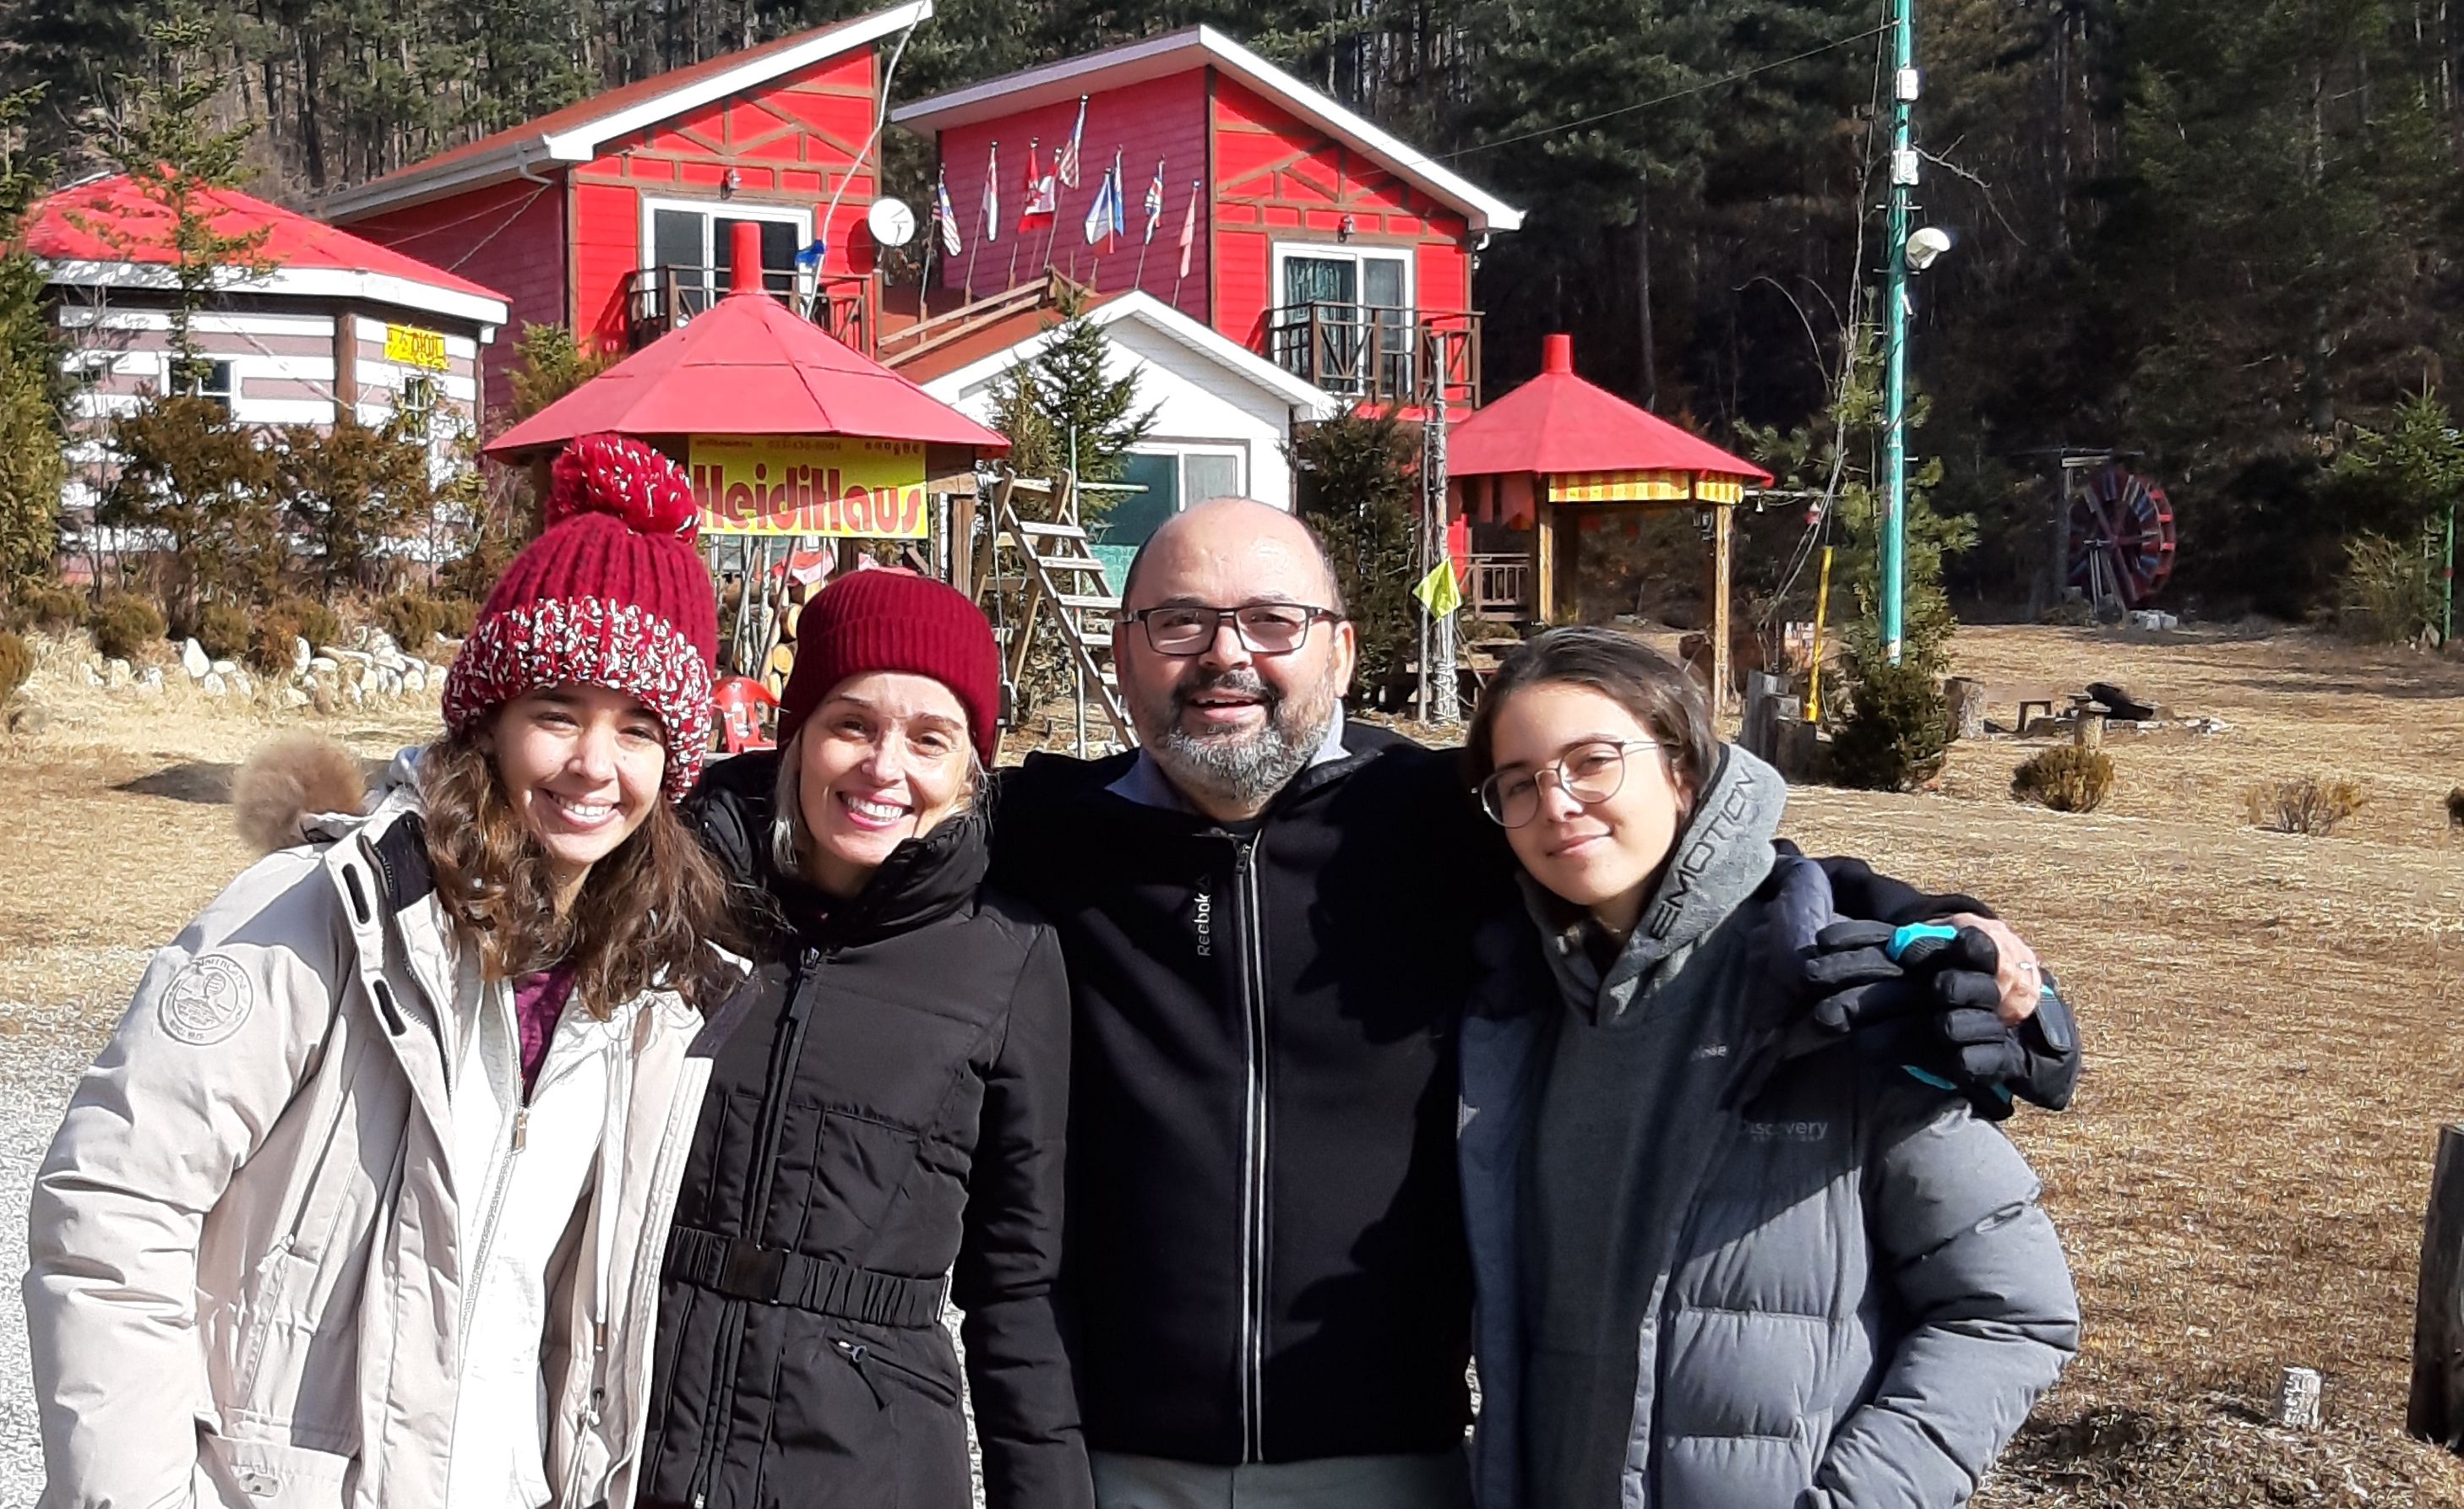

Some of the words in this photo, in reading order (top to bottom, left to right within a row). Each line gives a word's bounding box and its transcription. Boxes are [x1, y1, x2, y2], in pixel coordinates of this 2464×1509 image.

[694, 463, 922, 533] HeidiHaus
[1649, 765, 1756, 941] EMOTION
[1194, 892, 1211, 956] Reebok
[1743, 1120, 1829, 1140] iscvery
